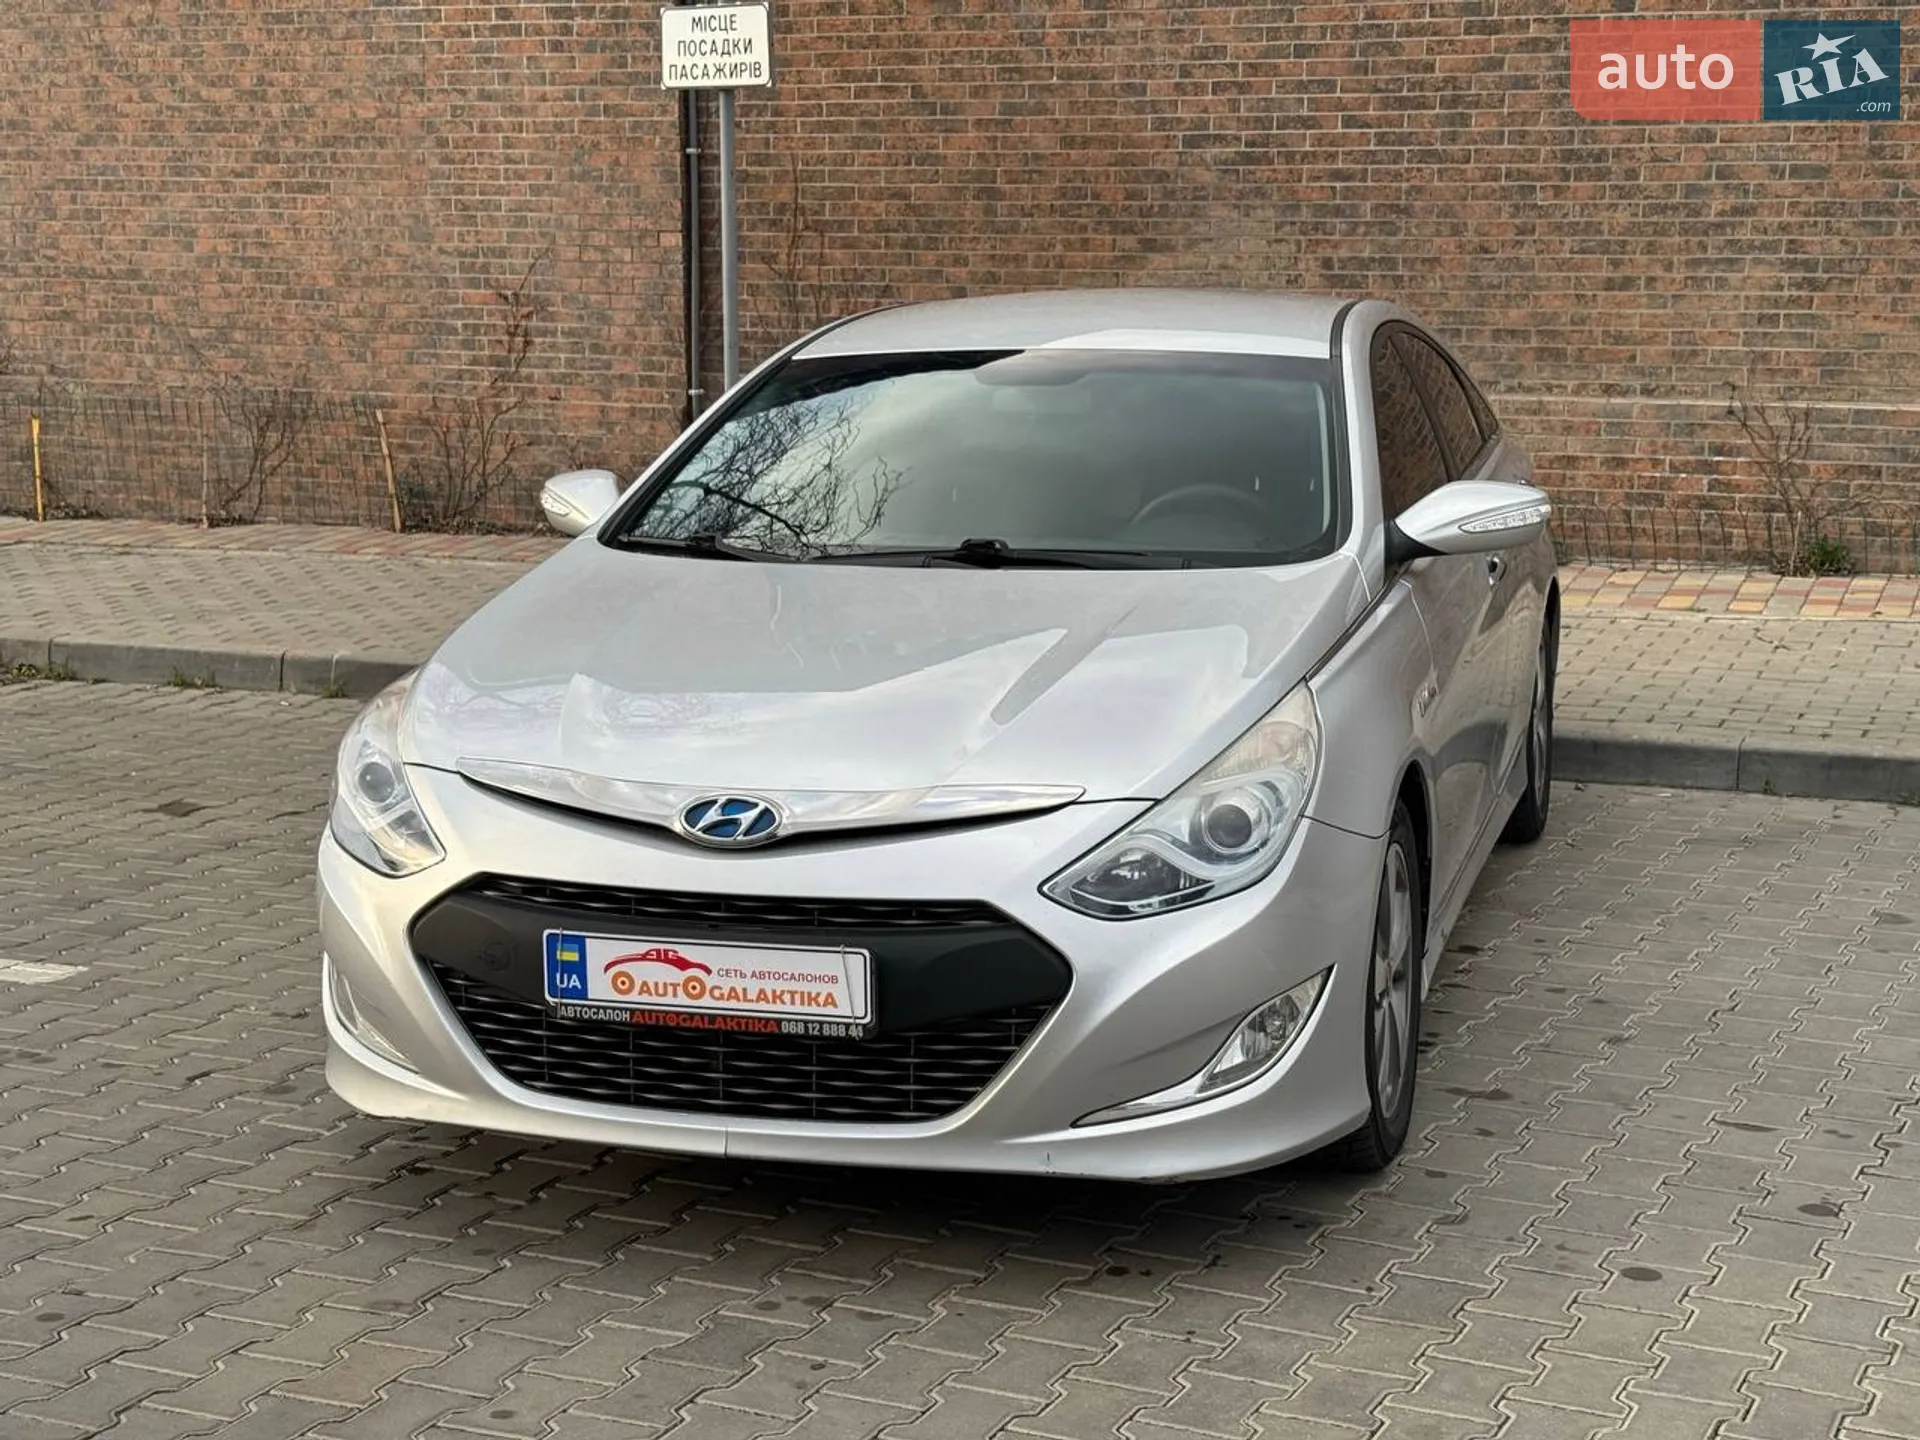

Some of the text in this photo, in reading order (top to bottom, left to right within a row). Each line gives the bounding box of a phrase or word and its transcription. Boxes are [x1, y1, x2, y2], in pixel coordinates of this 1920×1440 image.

[691, 14, 738, 34] МІСЦЕ
[677, 37, 753, 58] ПОСАДКИ
[668, 61, 763, 81] ПАСАЖИРІВ
[556, 973, 582, 990] UA
[716, 967, 839, 985] СЕТЬ АВТОСАЛОНОВ
[559, 1004, 631, 1022] АВТОСАЛОН
[631, 1010, 779, 1035] AUTOGALAKTIKA
[806, 1022, 820, 1036] 12
